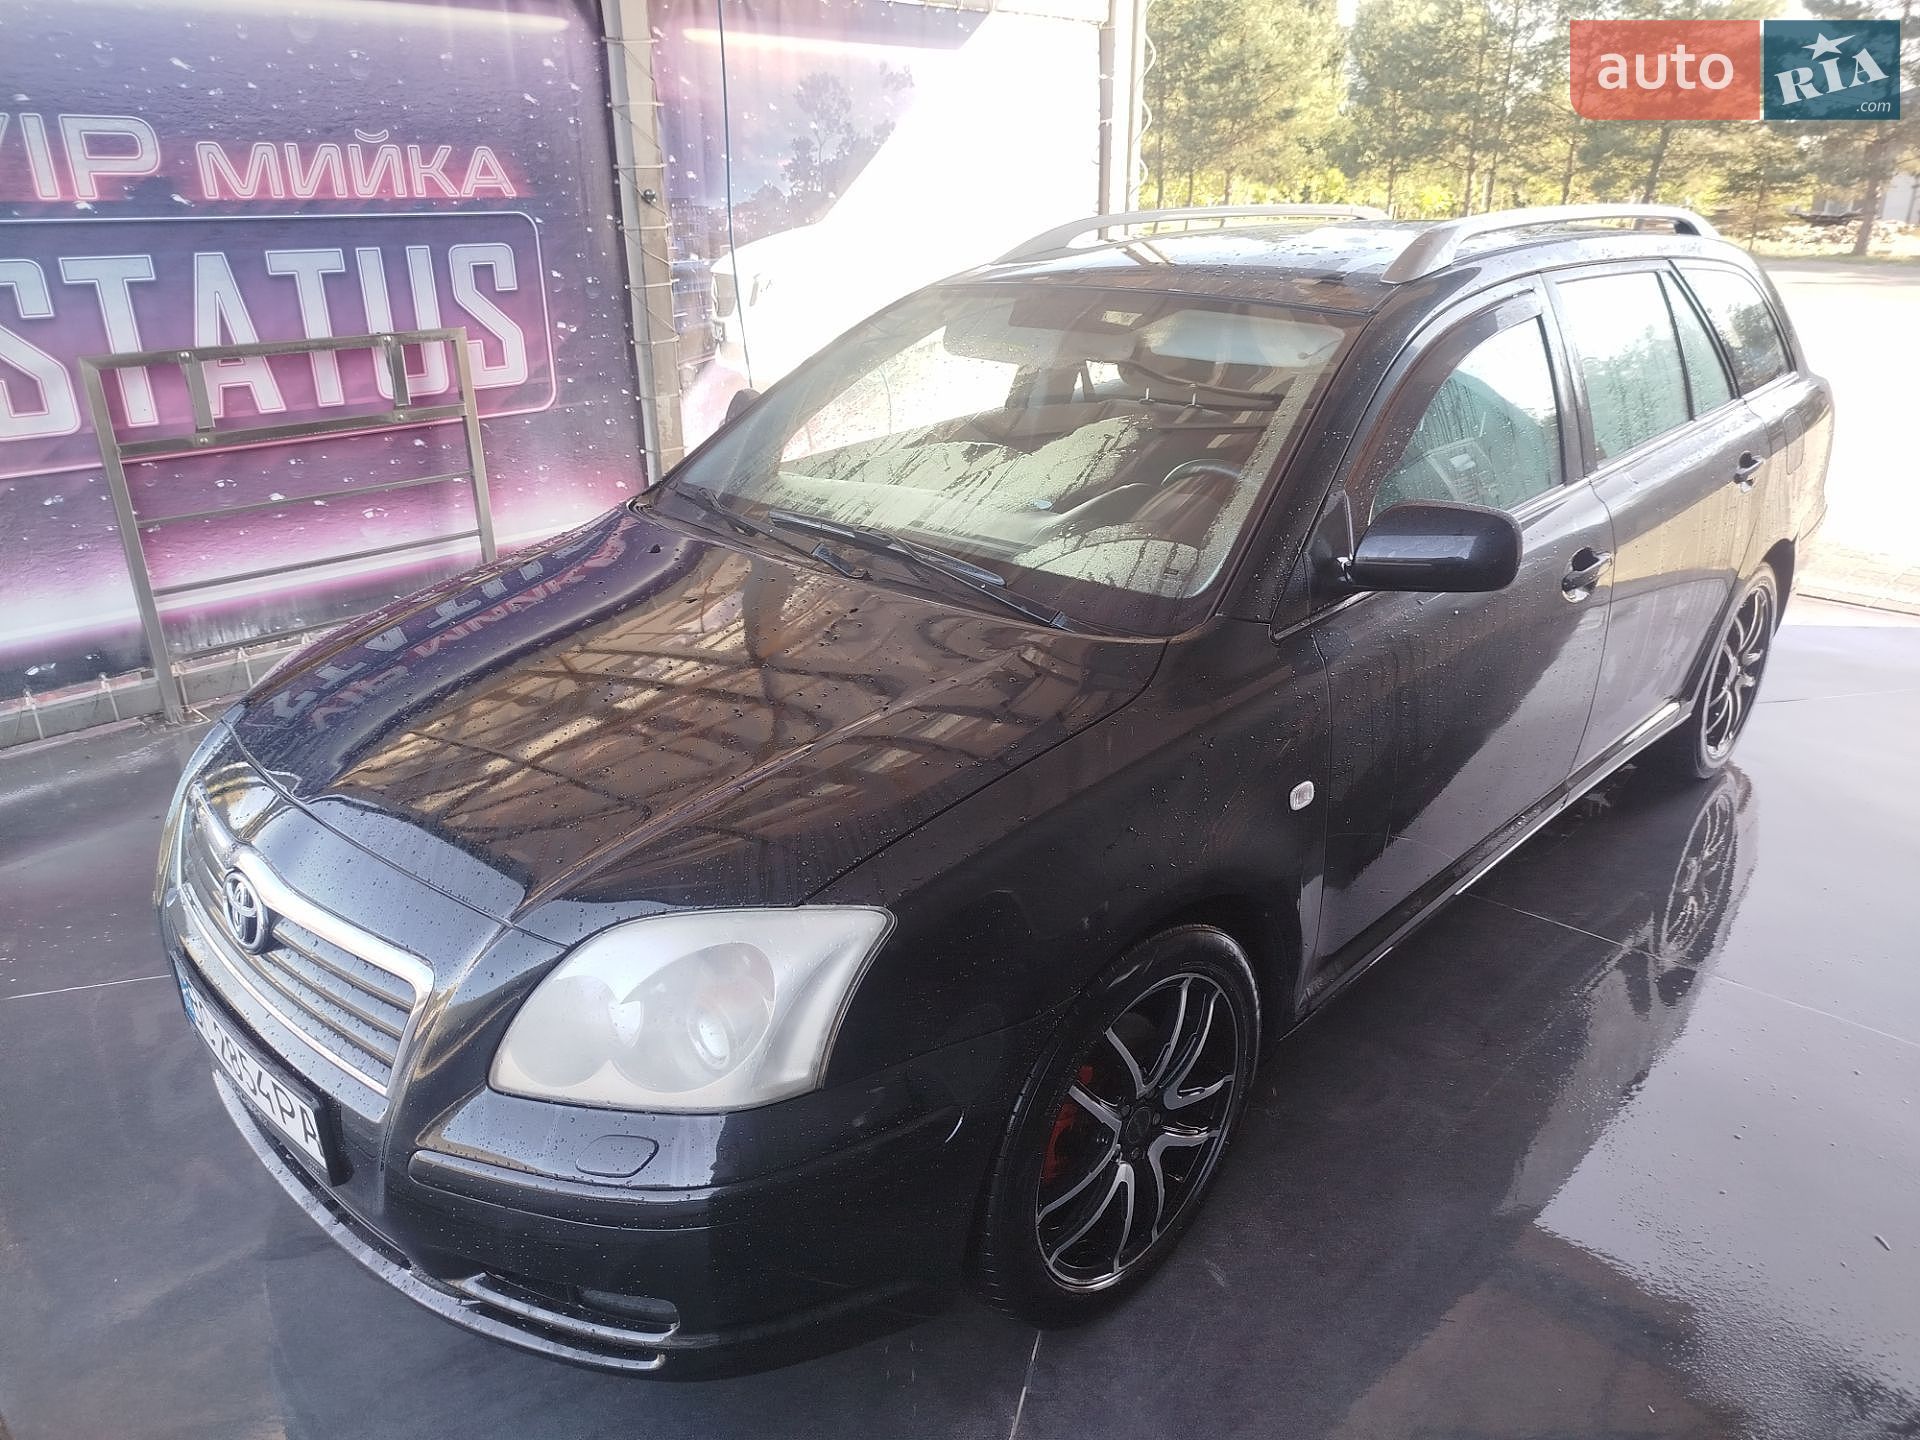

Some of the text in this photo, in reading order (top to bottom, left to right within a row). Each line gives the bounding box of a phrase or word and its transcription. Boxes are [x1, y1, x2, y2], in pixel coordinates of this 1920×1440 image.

[0, 112, 517, 200] IP МИЙКА
[0, 242, 529, 442] STATUS
